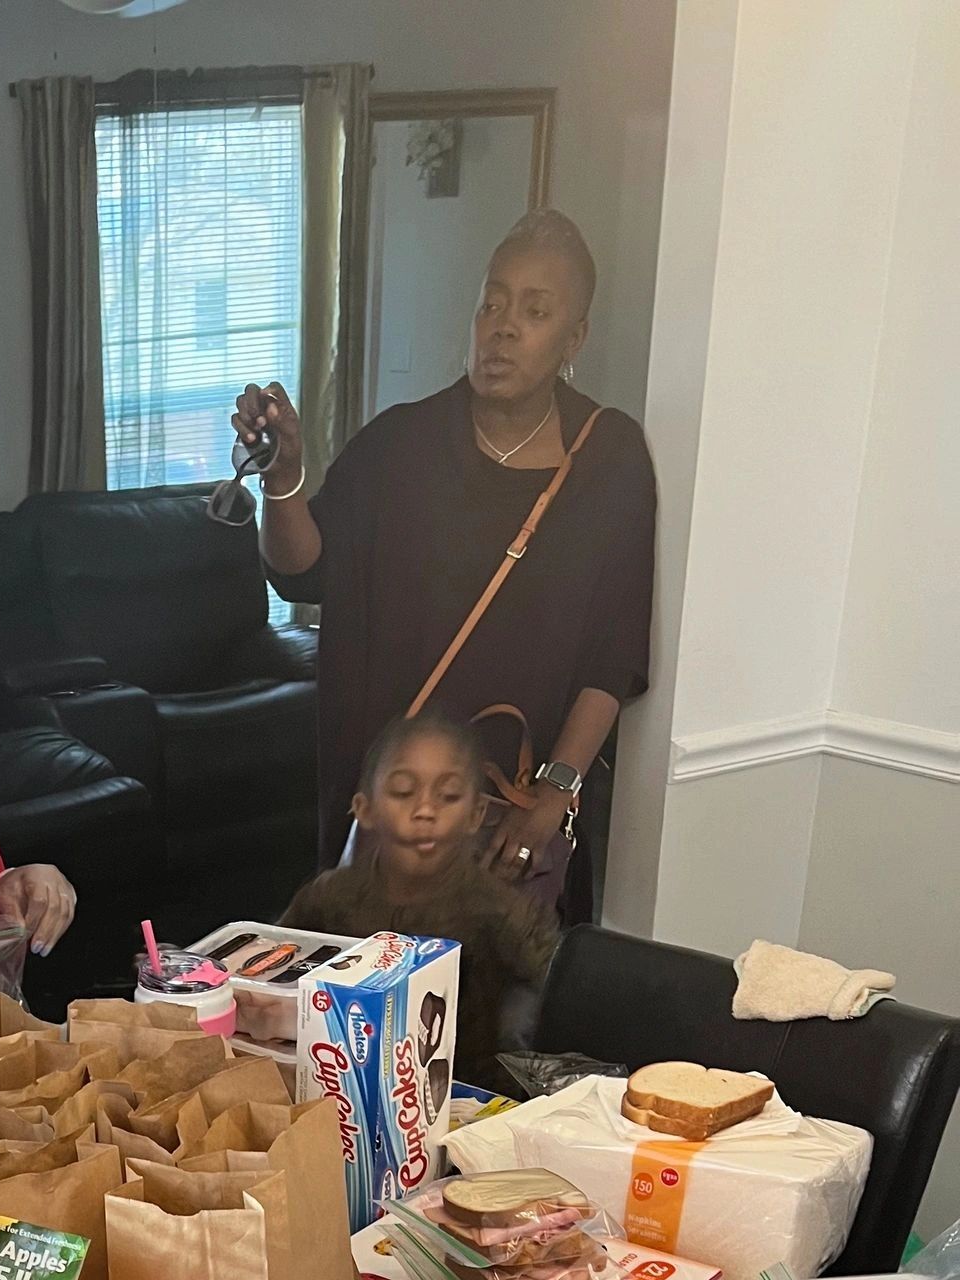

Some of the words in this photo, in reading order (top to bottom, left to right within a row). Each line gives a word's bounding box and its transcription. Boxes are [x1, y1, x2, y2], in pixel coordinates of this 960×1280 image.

[315, 993, 329, 1012] 16
[349, 1011, 367, 1063] Hostess
[393, 1038, 428, 1189] CupCakes
[634, 1178, 653, 1194] 150
[19, 1229, 52, 1243] Extended
[0, 1240, 68, 1274] Apples
